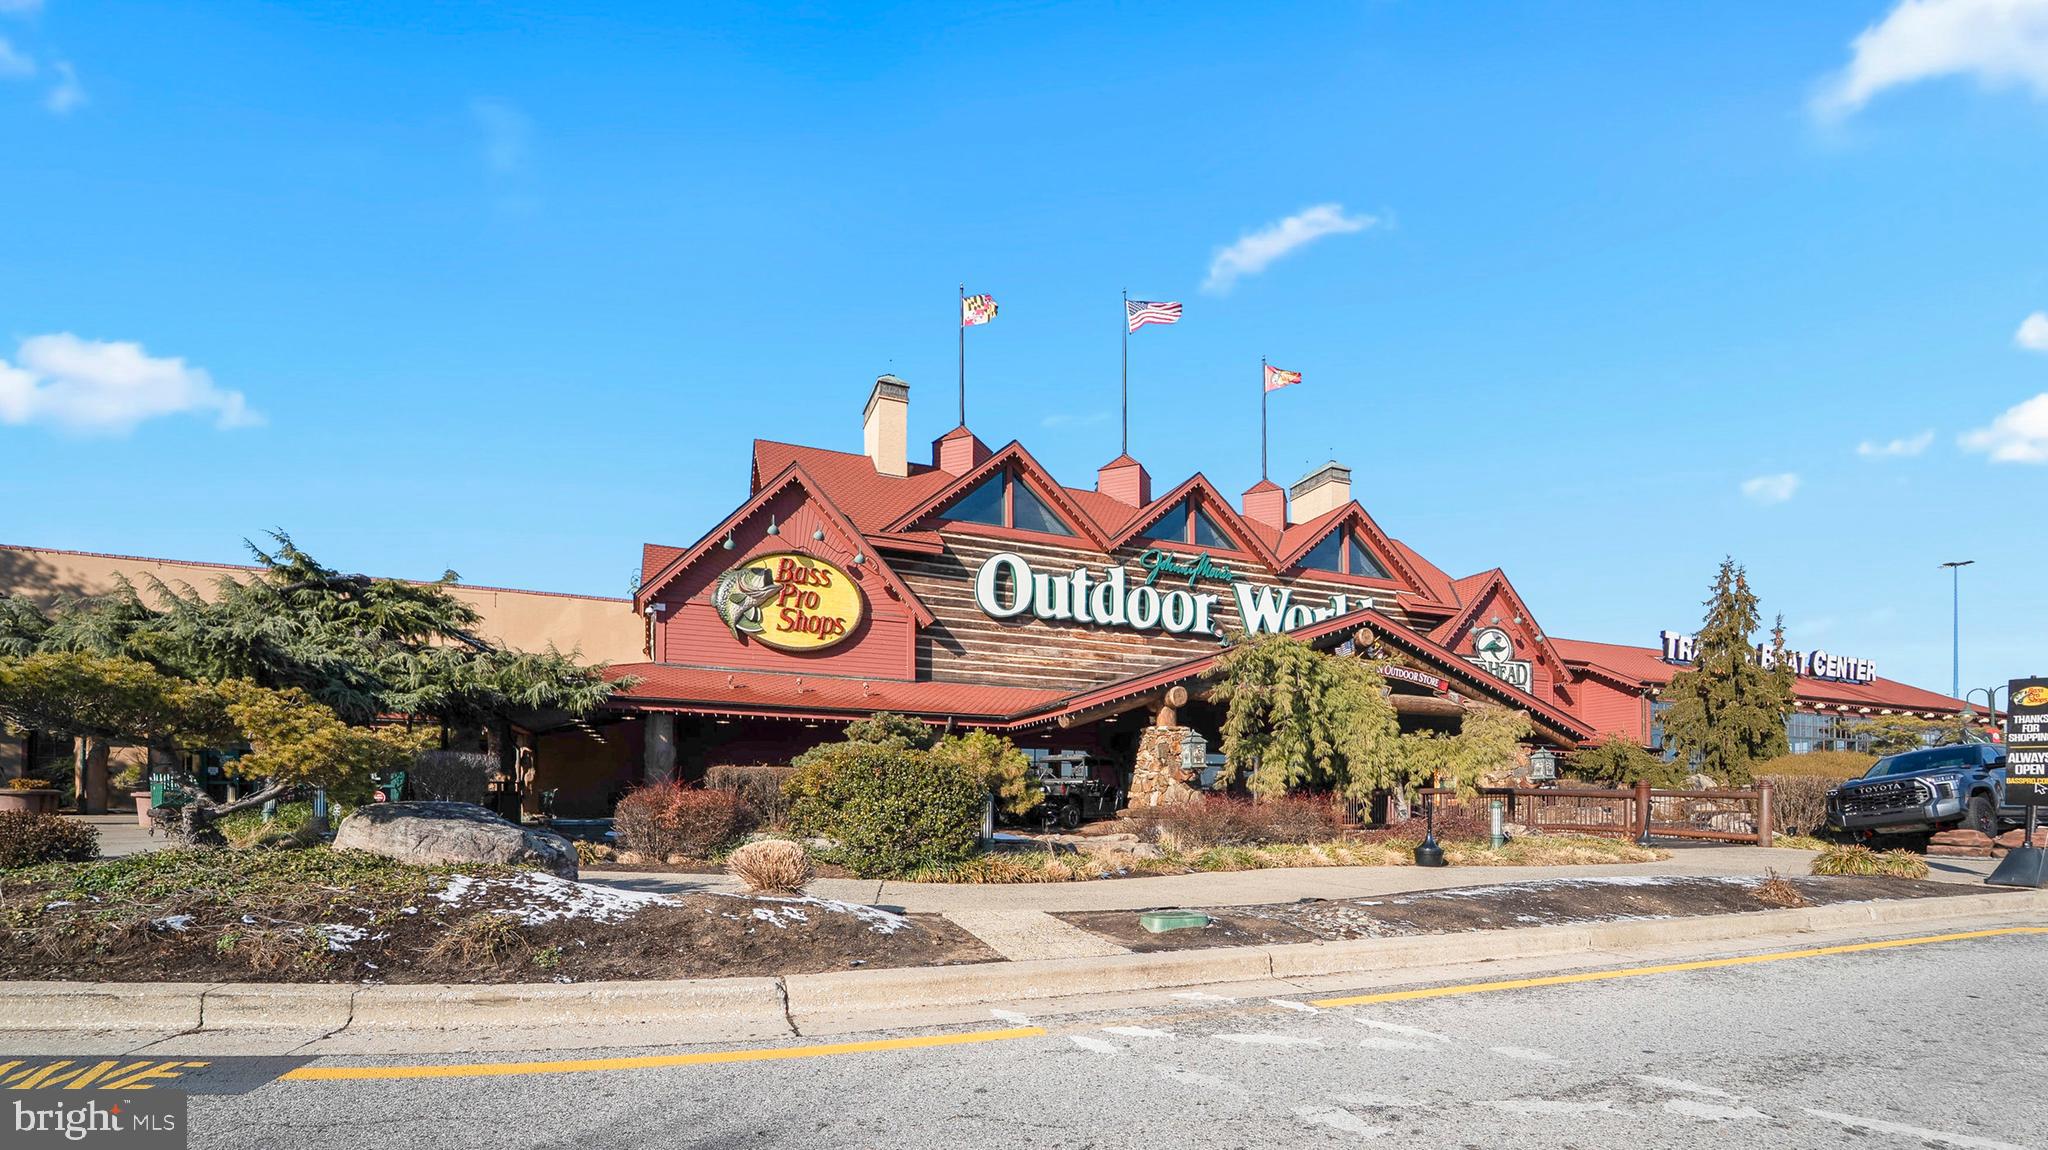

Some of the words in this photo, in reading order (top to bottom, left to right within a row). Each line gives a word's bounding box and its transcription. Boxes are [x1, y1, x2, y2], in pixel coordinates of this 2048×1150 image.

[775, 558, 833, 587] Bass
[776, 583, 818, 609] Pro
[975, 552, 1220, 635] Outdoor
[1232, 583, 1374, 638] Wor
[776, 607, 847, 639] Shops
[1384, 664, 1418, 681] OUTDOOR
[1419, 673, 1439, 687] STORE
[1480, 661, 1527, 686] HEAD
[1813, 649, 1877, 682] CENTER
[2013, 714, 2048, 724] THANKS
[2022, 724, 2040, 732] FOR
[2009, 733, 2048, 742] SHOPPIN
[2015, 764, 2045, 775] OPEN
[1859, 783, 1901, 794] TOYOTA
